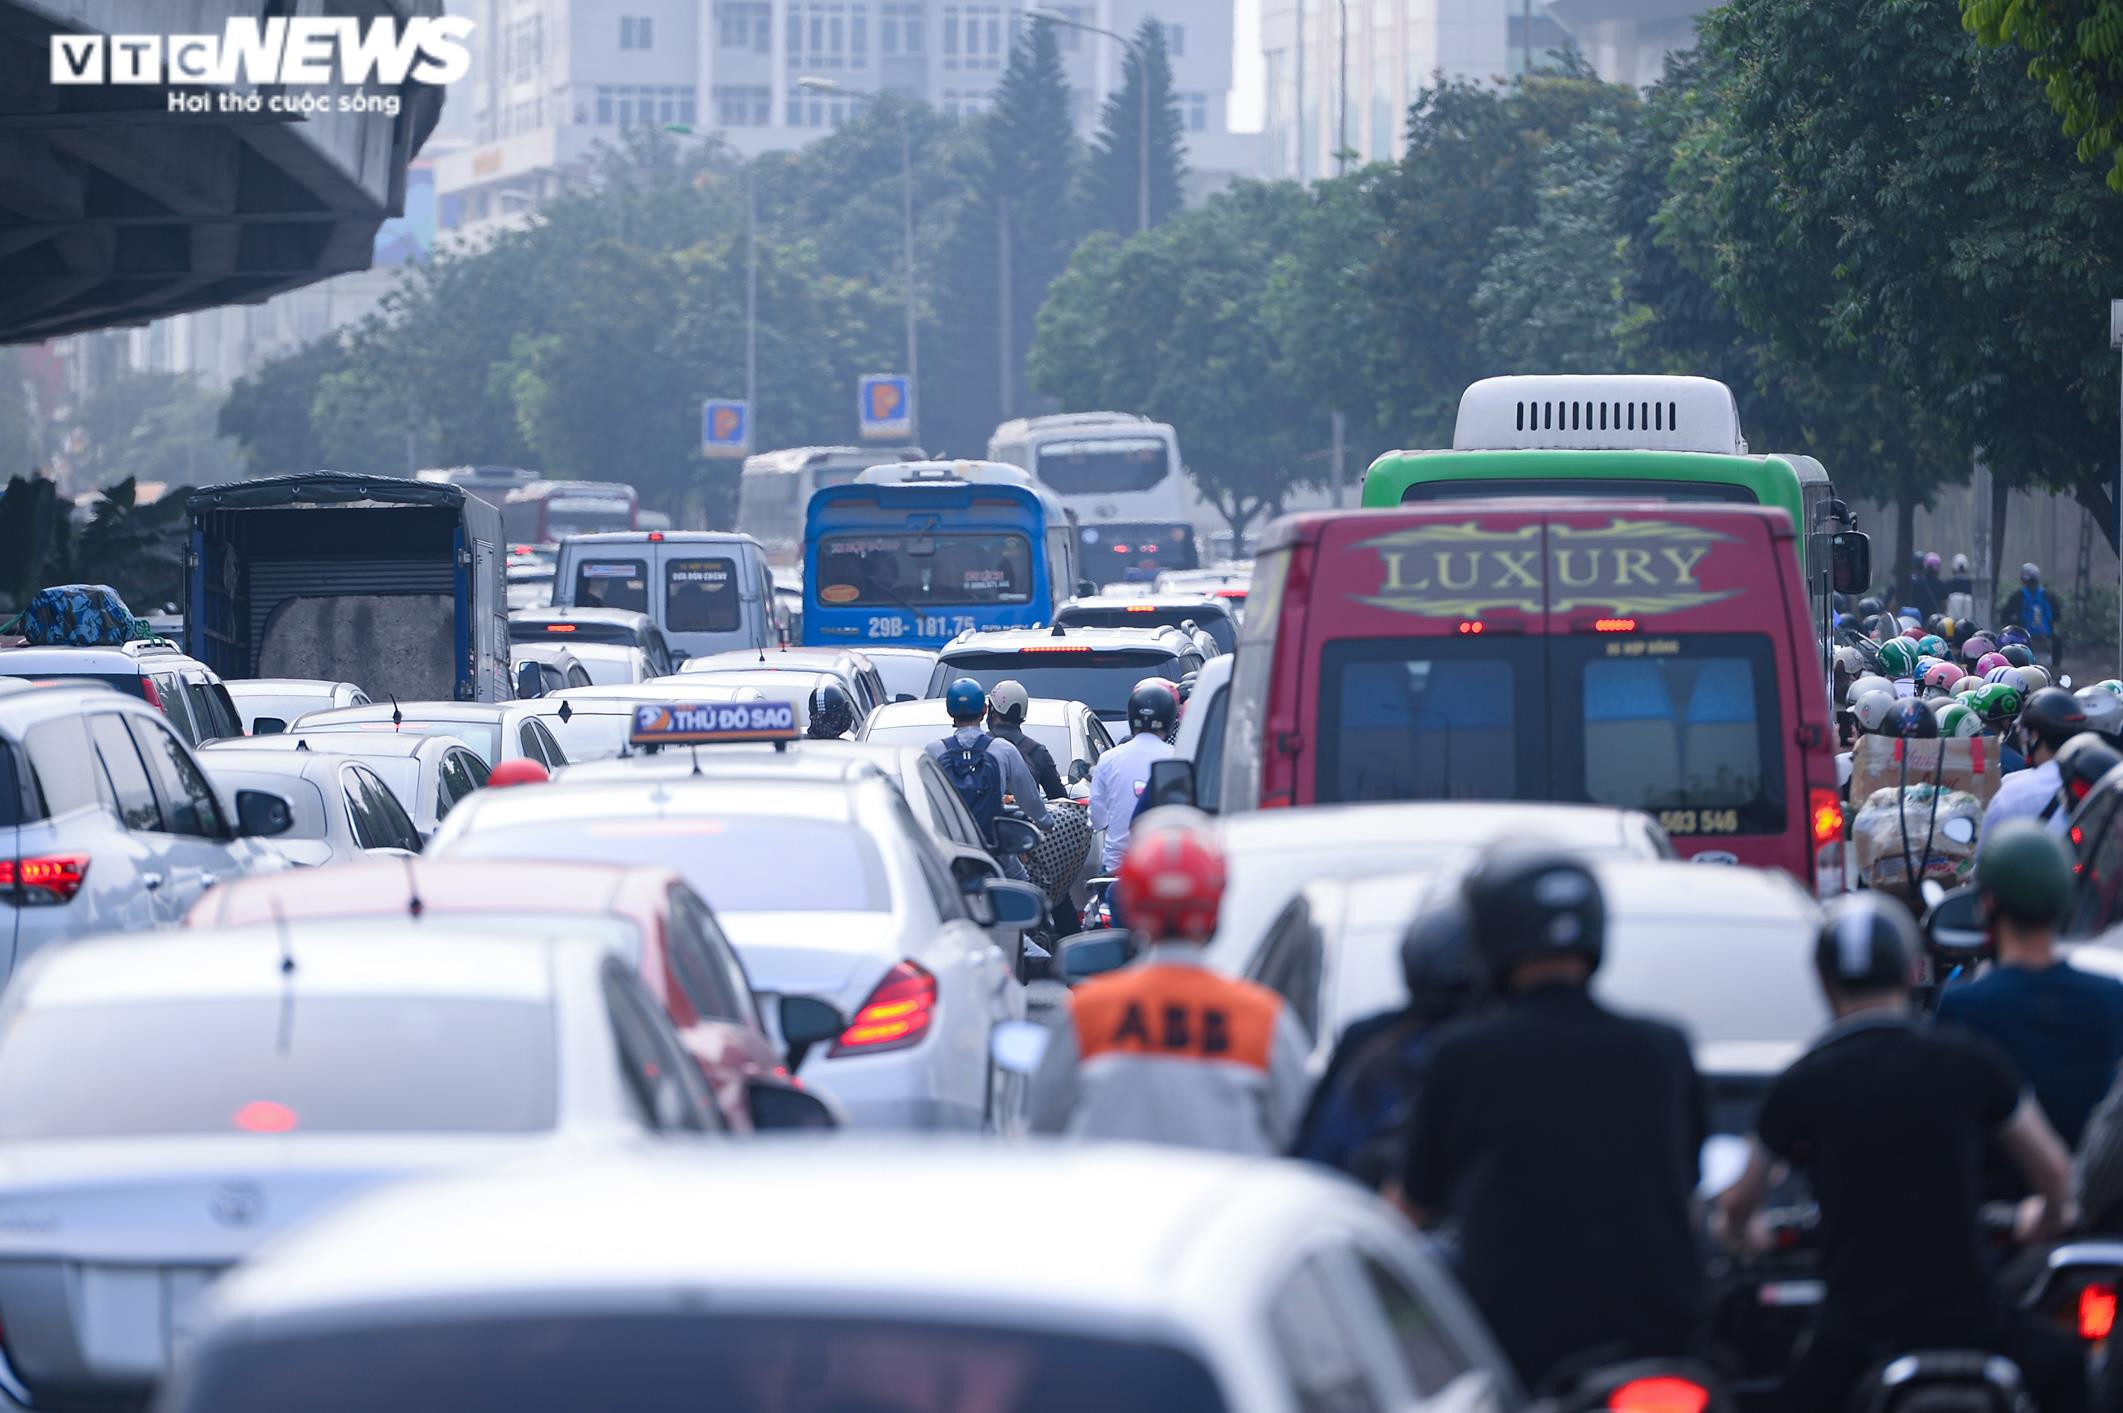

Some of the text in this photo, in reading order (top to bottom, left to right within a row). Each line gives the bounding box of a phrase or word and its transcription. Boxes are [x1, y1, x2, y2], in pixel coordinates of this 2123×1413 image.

[1383, 547, 1709, 591] LUXURY
[675, 704, 793, 731] THỦ ĐÔ SAO
[1111, 999, 1231, 1054] ABB
